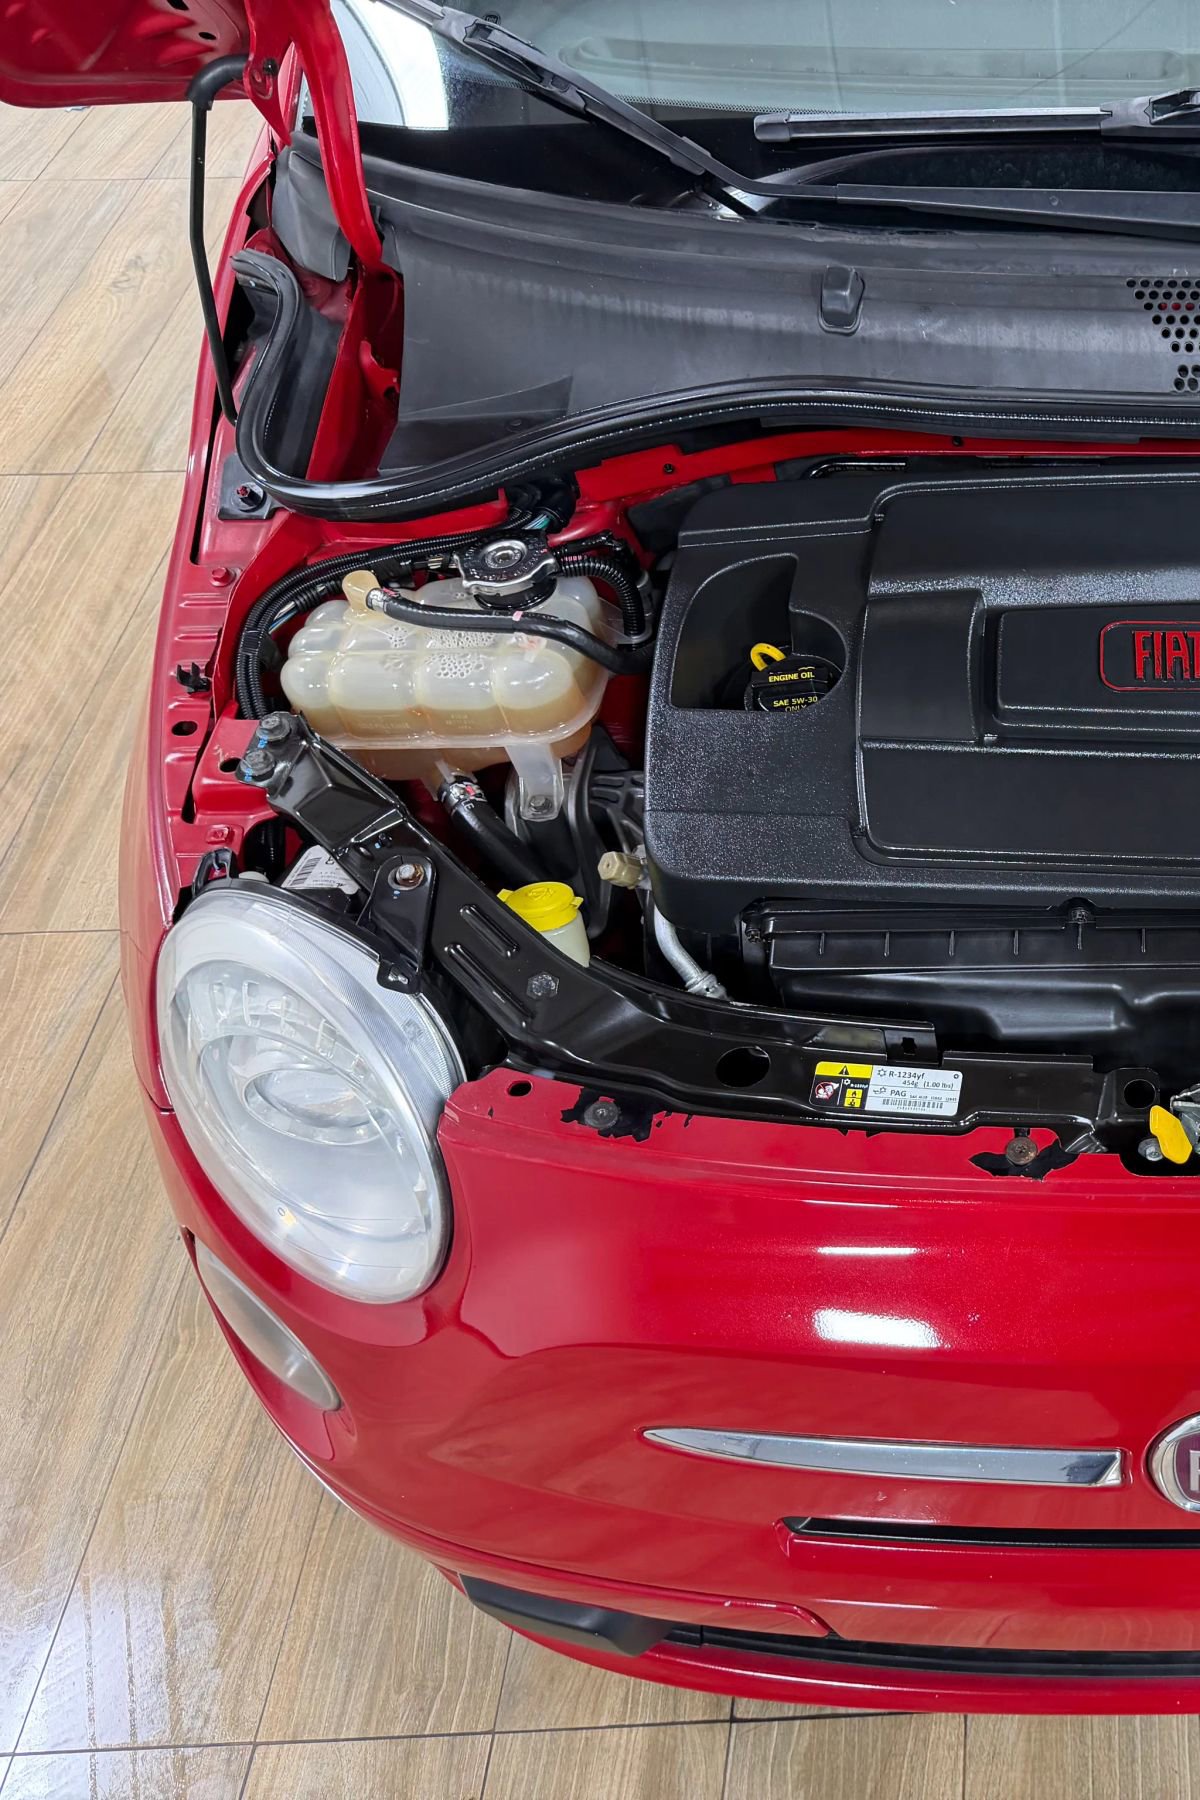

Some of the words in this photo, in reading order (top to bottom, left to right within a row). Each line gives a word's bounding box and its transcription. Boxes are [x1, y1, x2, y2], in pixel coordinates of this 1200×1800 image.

[768, 673, 798, 682] ENGINE
[773, 699, 789, 707] SAE
[791, 696, 818, 704] 5W-30
[888, 1070, 926, 1081] R-1234yf
[902, 1080, 918, 1088] 454g
[923, 1080, 940, 1088] (1.00
